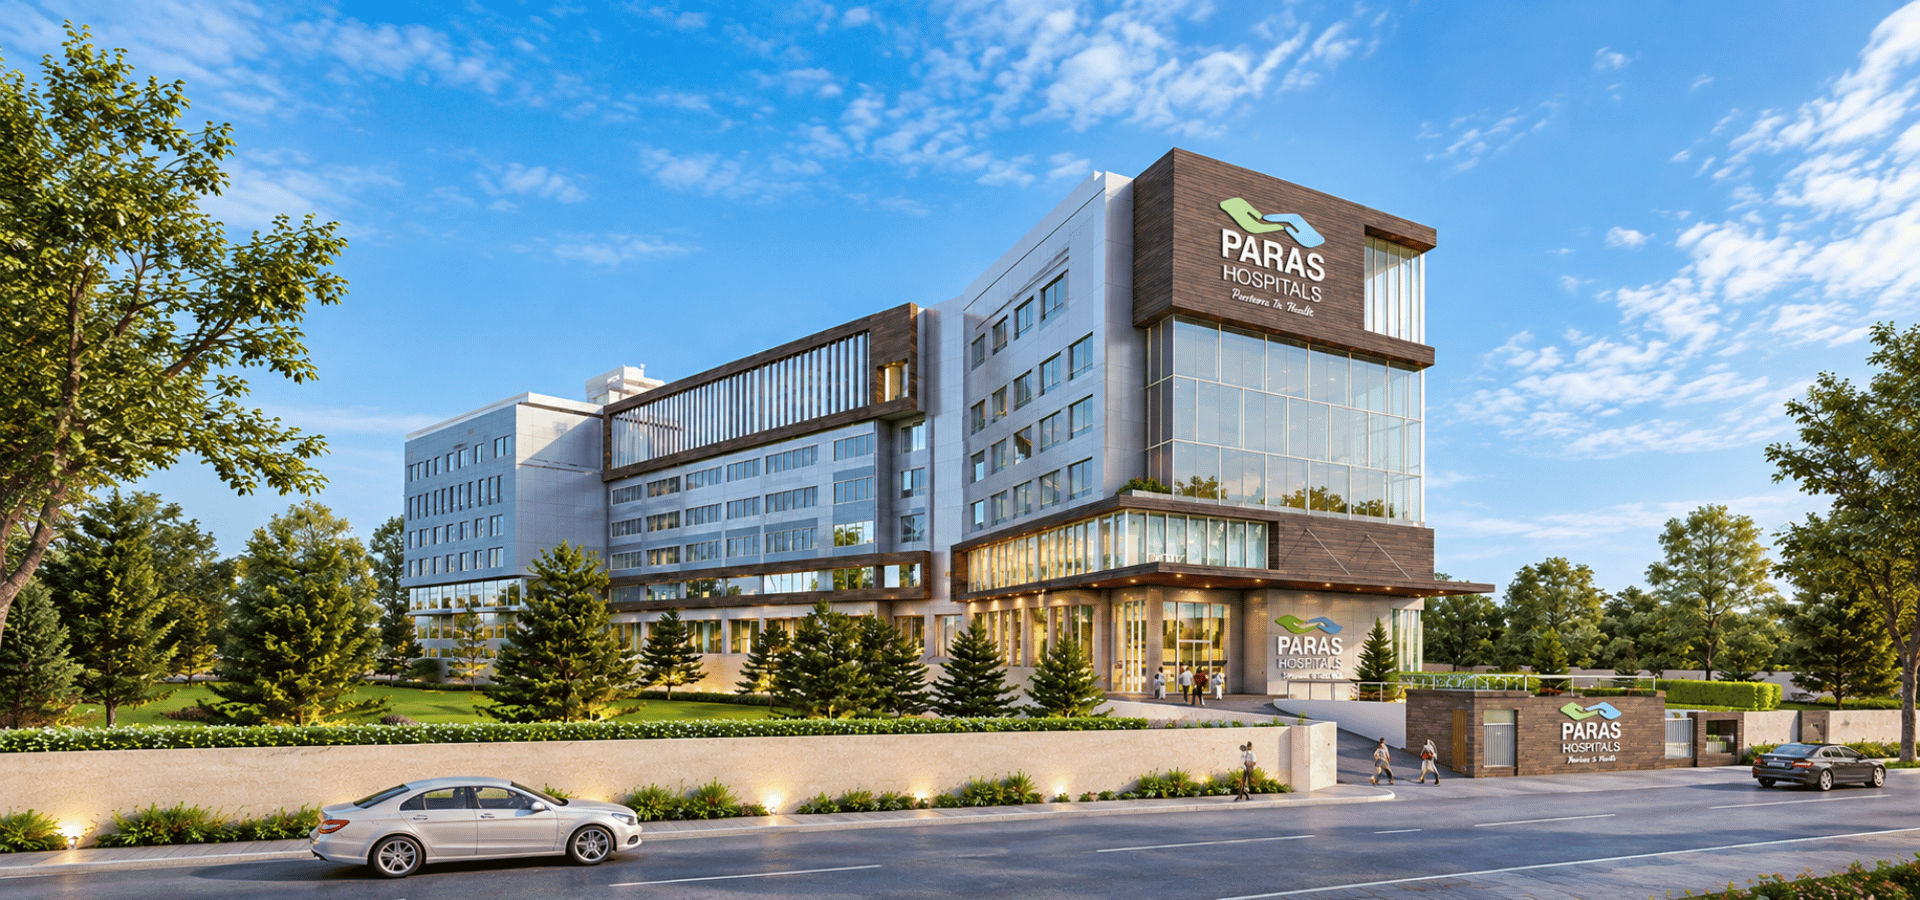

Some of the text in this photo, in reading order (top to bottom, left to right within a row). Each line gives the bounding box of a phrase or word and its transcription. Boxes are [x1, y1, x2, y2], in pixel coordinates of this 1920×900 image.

[1221, 228, 1326, 282] PARAS
[1223, 264, 1322, 302] HOSPITALS
[1277, 636, 1343, 656] PARAS
[1562, 722, 1622, 740] PARAS
[1562, 742, 1621, 753] HOSPITALS
